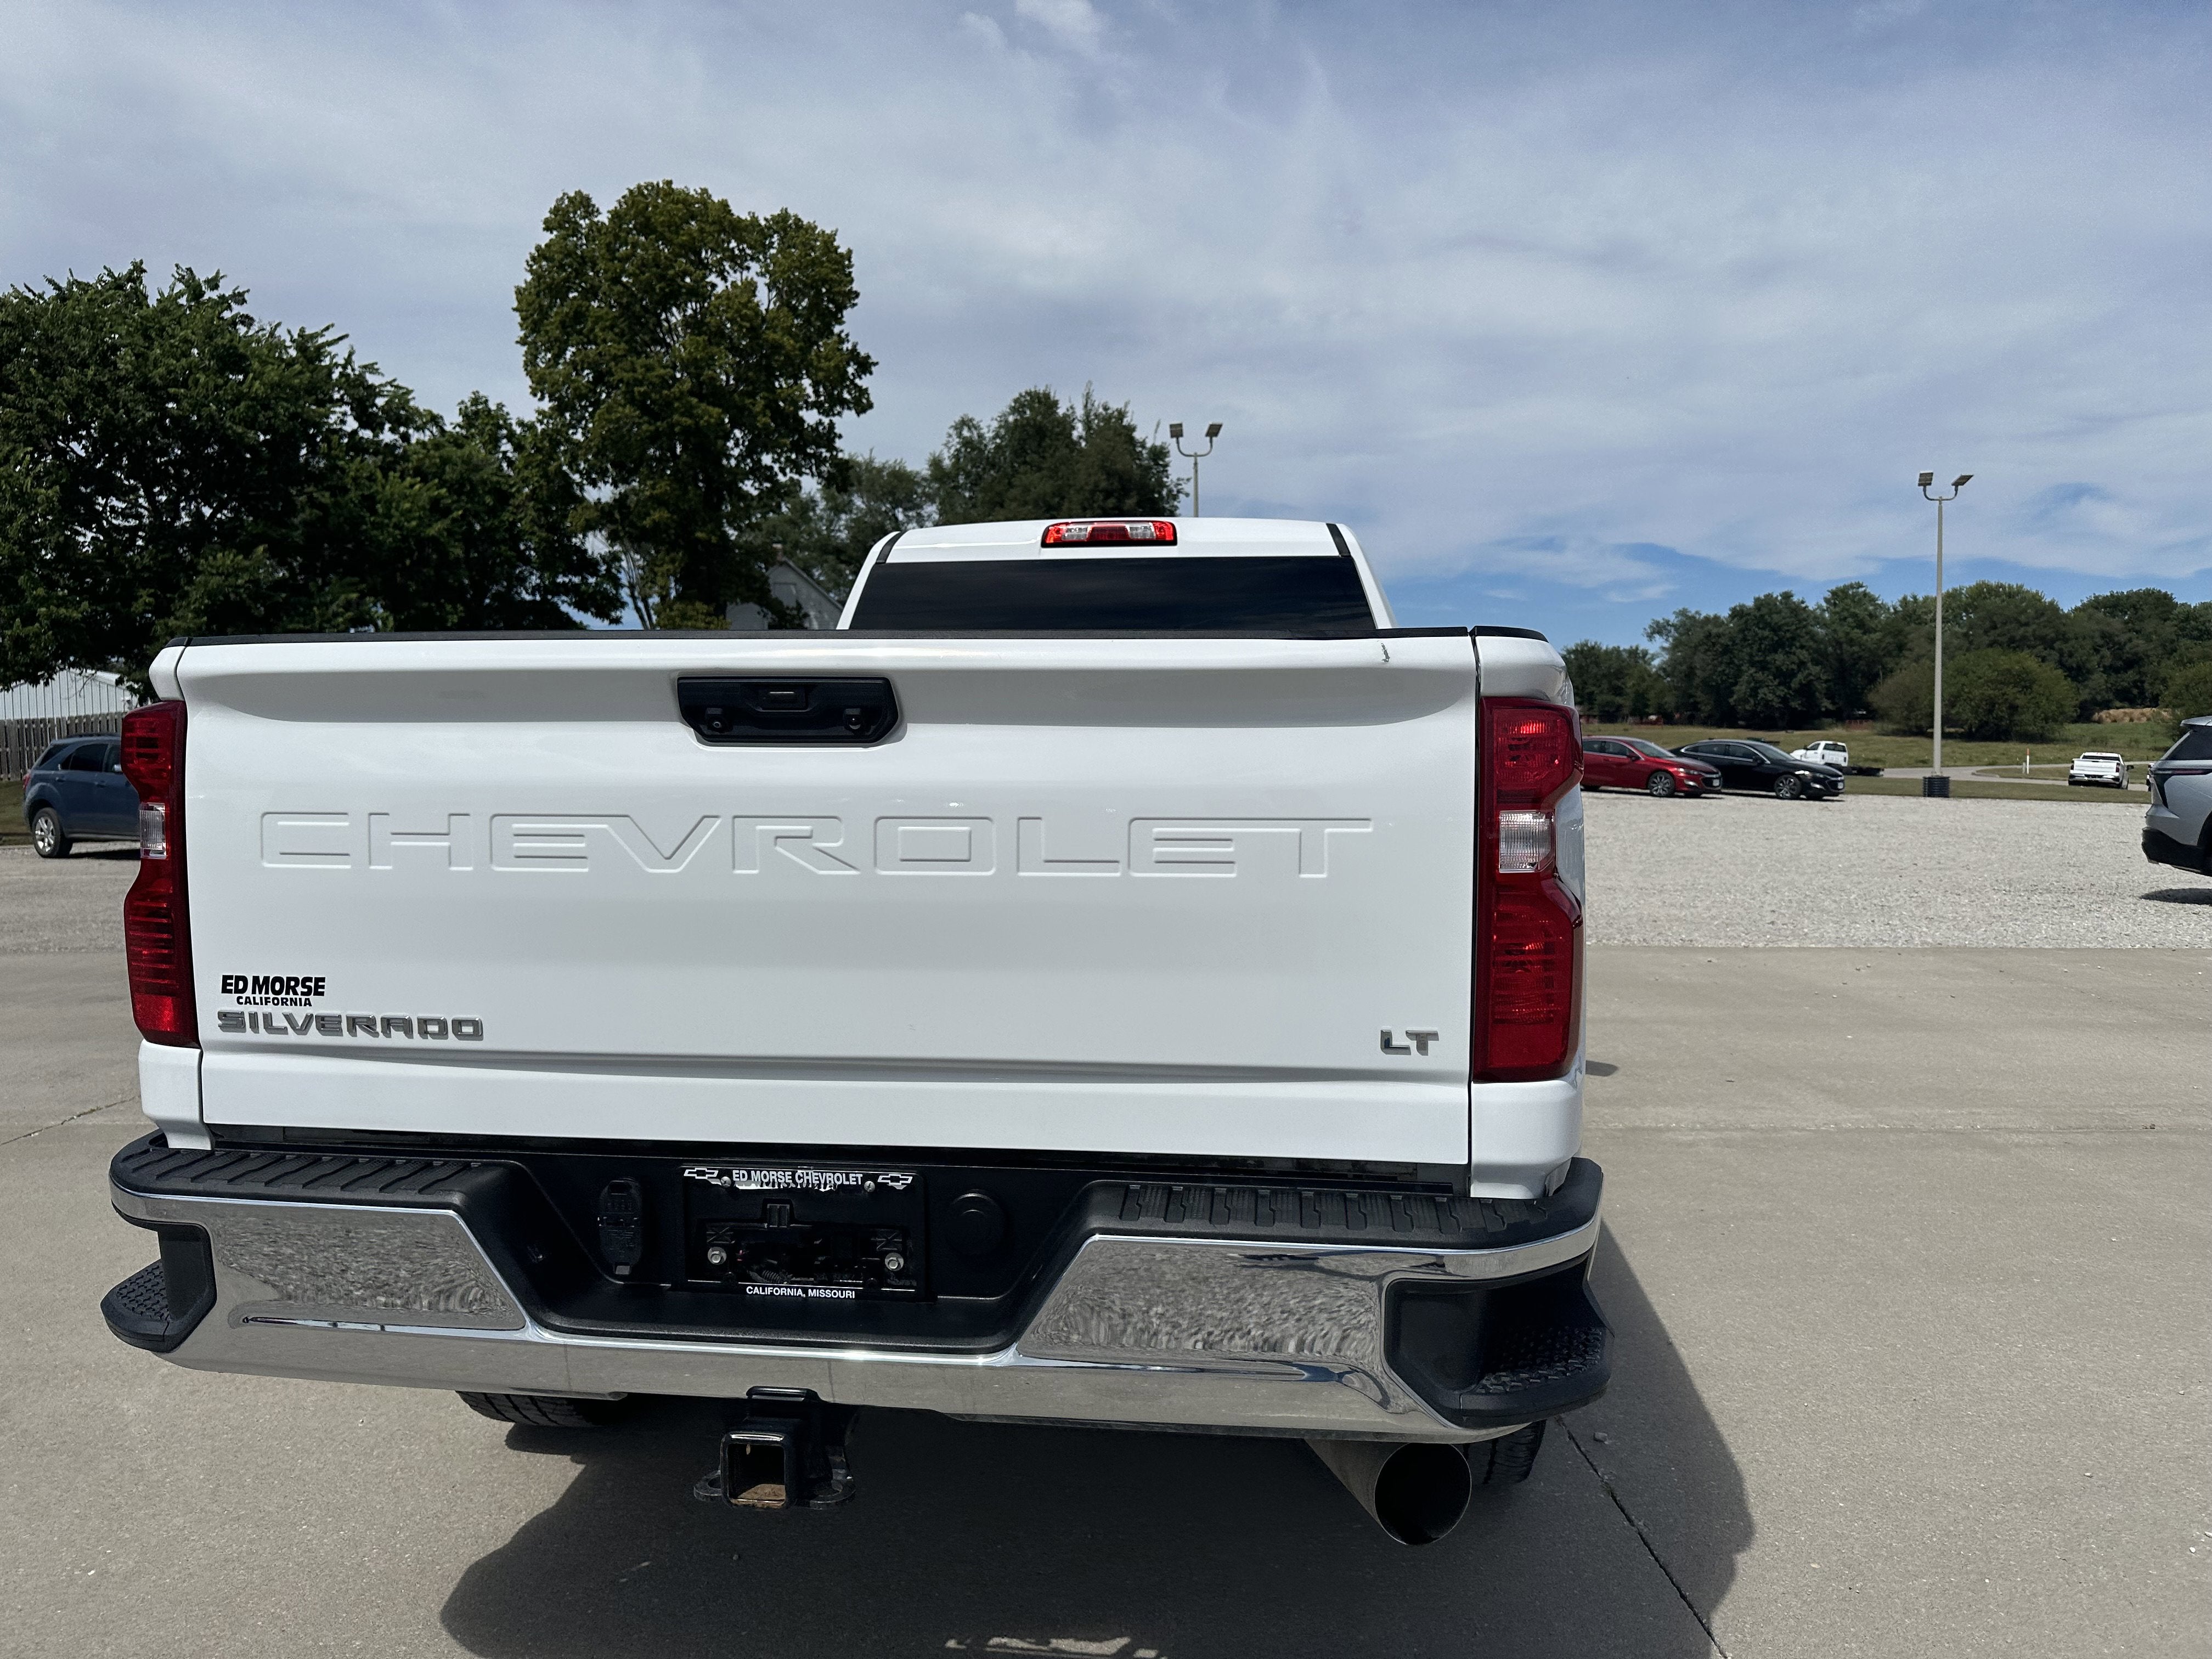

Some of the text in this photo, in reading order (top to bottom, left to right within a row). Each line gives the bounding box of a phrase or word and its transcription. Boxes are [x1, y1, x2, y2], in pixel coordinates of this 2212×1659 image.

[261, 811, 1374, 878] CHEVROLET
[221, 974, 326, 997] ED MORSE
[236, 996, 312, 1007] CALIFORNIA
[218, 1009, 484, 1041] SILVERADO
[1380, 1029, 1439, 1056] LT
[732, 1170, 863, 1185] ED MORSE CHEVROLET
[746, 1285, 855, 1299] CALIFORNIA, MISSOURI
